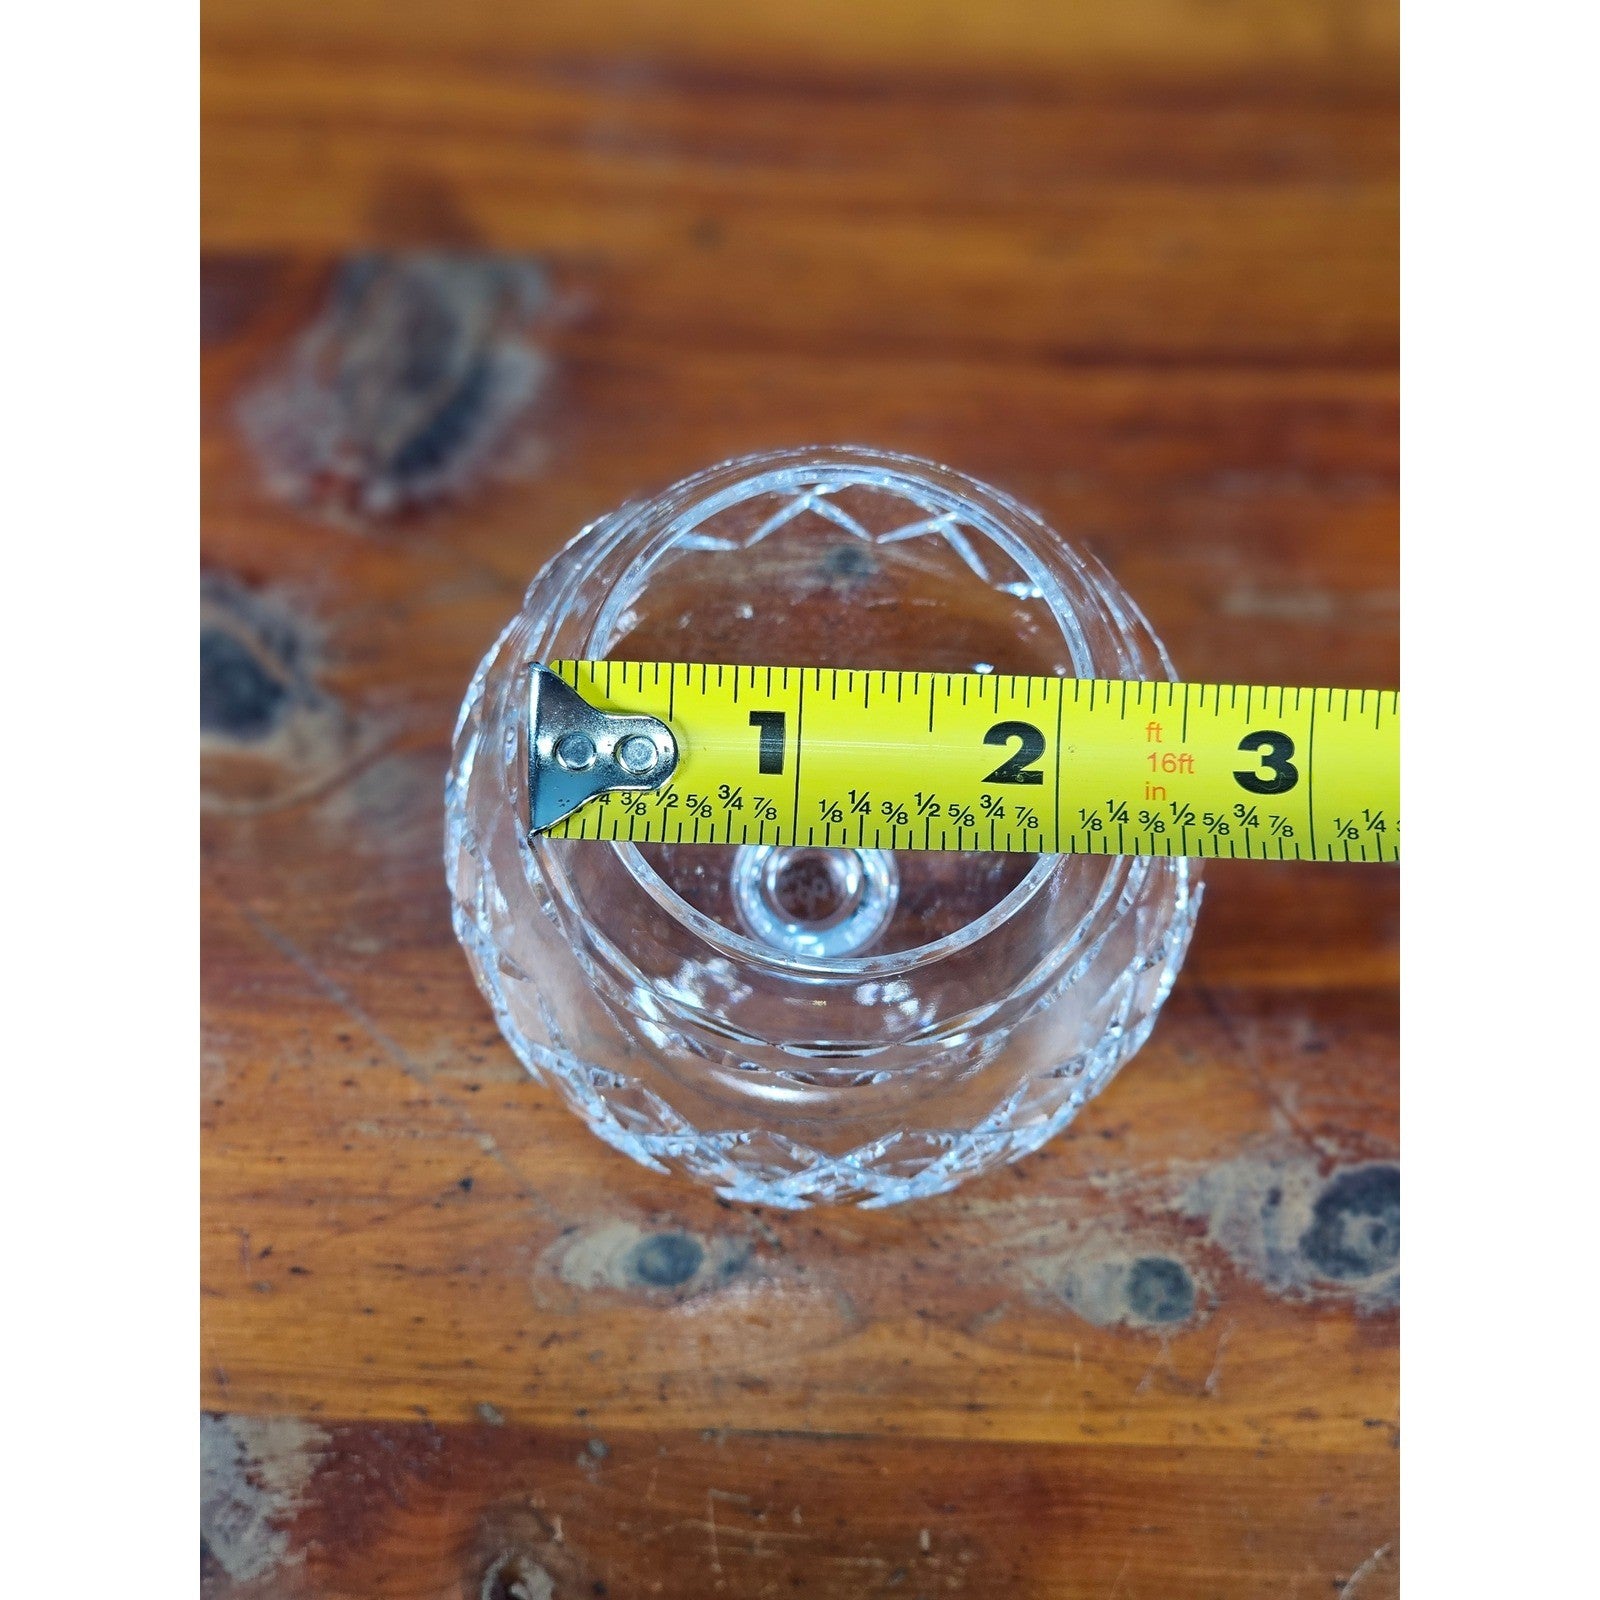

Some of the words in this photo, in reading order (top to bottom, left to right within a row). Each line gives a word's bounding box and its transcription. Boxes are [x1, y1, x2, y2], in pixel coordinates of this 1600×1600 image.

[1145, 721, 1163, 744] ft
[748, 710, 786, 776] 1
[981, 720, 1046, 786] 2
[1232, 729, 1299, 795] 3
[1146, 752, 1195, 775] 16ft
[1145, 781, 1167, 802] in
[685, 794, 712, 819] 5/8
[717, 784, 744, 811] 3/4
[753, 797, 777, 821] 7/8
[818, 799, 843, 823] 1/8
[848, 789, 872, 815] 1/4
[880, 801, 909, 825] 3/8
[914, 791, 941, 818] 1/2
[947, 803, 975, 827] 5/8
[979, 794, 1006, 820] 3/4
[1014, 806, 1039, 829] 7/8
[1078, 808, 1103, 832] 1/8
[1106, 799, 1130, 824] 1/4
[1138, 810, 1166, 834] 3/8
[1169, 801, 1196, 827] 1/2
[1202, 812, 1230, 836] 5/8
[1233, 803, 1260, 828] 3/4
[1268, 814, 1294, 838] 7/8
[1333, 817, 1360, 840] 1/8
[1361, 808, 1387, 833] 1/4
